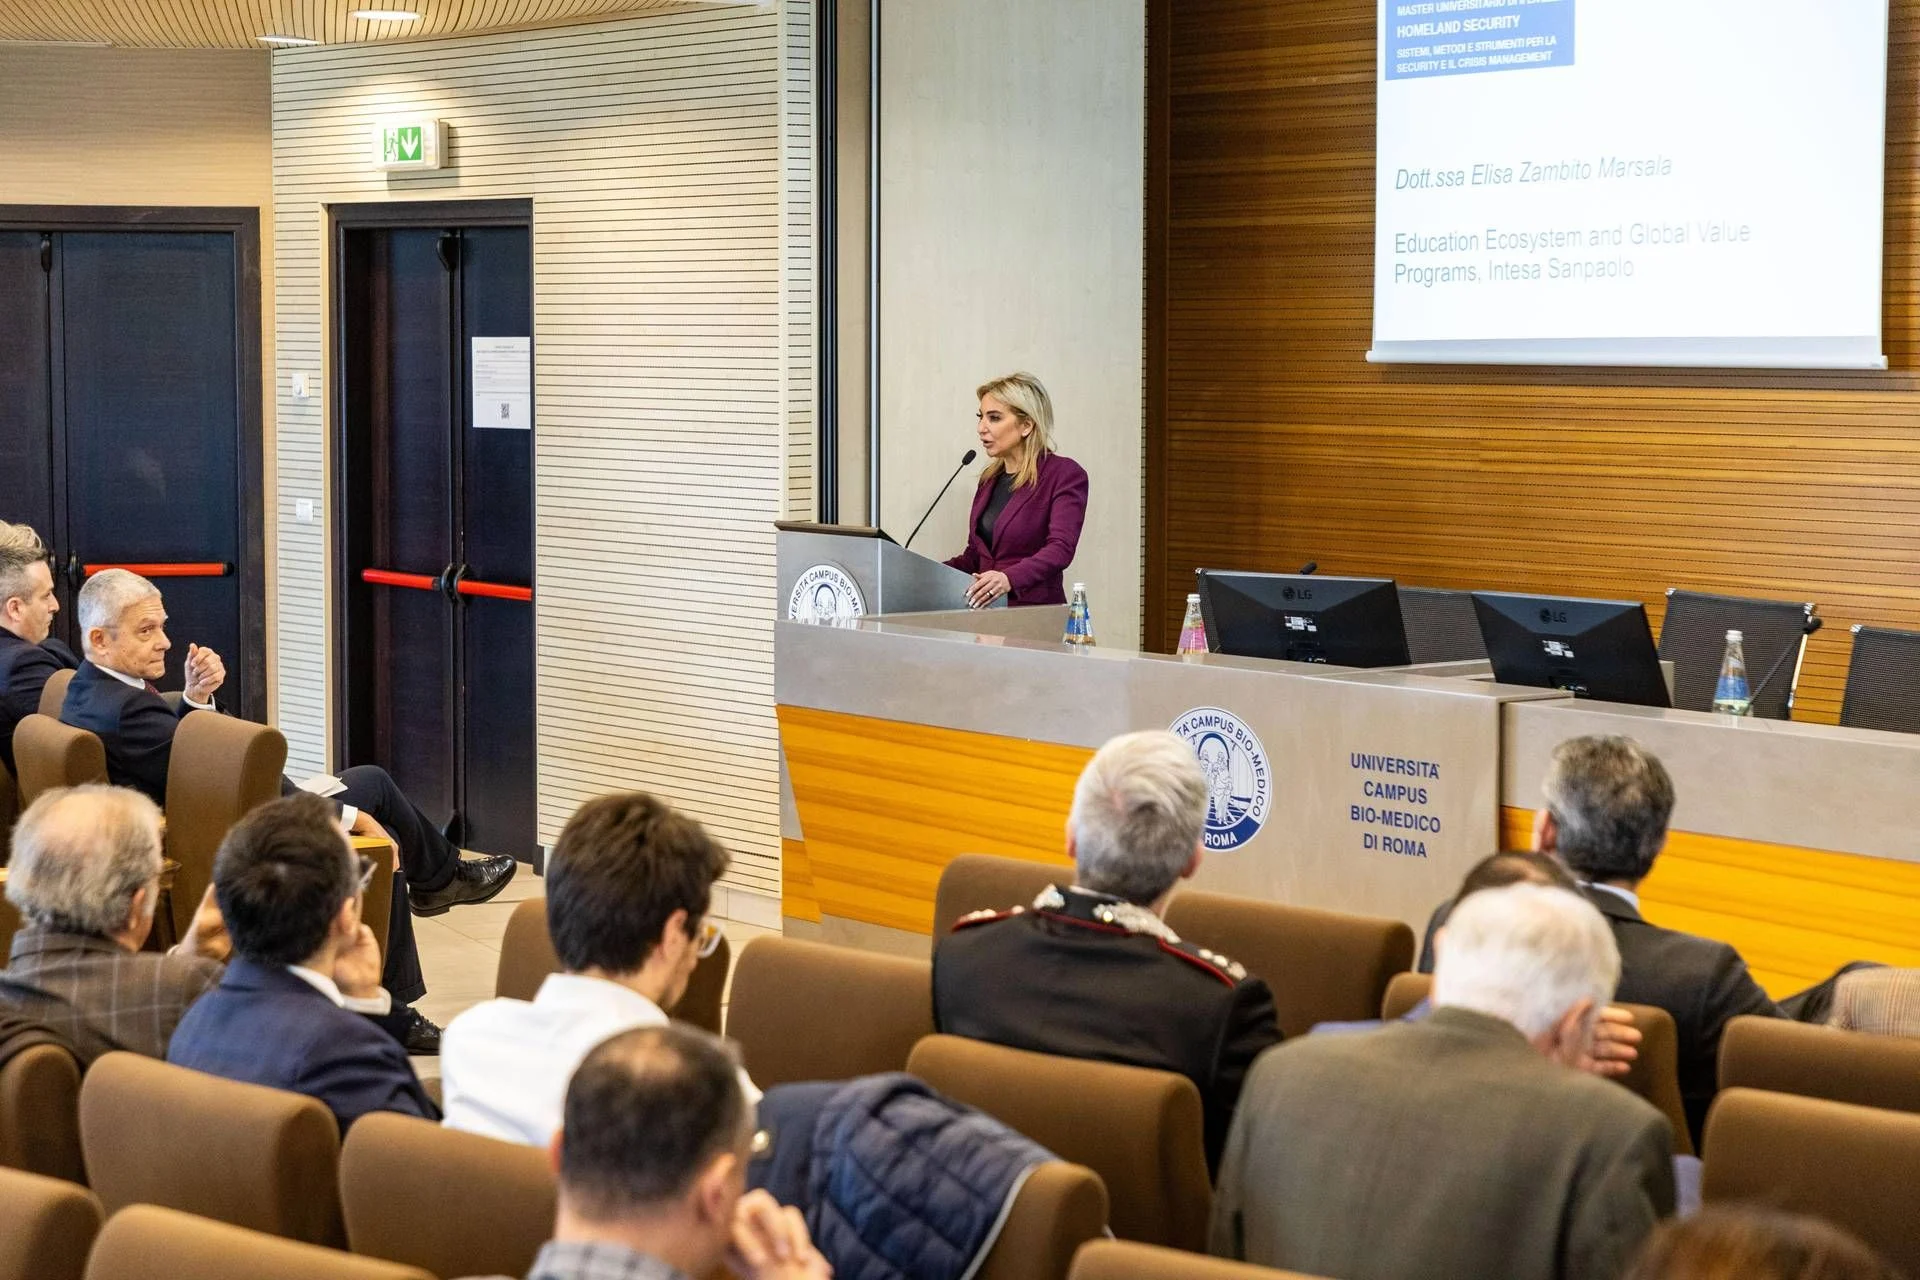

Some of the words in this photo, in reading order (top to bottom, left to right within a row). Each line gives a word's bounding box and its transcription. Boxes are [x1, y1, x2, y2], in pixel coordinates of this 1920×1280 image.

[1397, 3, 1434, 16] MASTER
[1397, 20, 1461, 38] HOMELAND
[1463, 15, 1520, 32] SECURITY
[1526, 36, 1544, 48] PER
[1545, 35, 1557, 46] LA
[1397, 60, 1439, 73] SECURITY
[1488, 51, 1552, 65] MANAGEMENT
[1395, 168, 1465, 190] Dott.ssa
[1471, 163, 1513, 186] Elisa
[1519, 159, 1592, 183] Zambito
[1597, 154, 1673, 179] Marsala
[1395, 231, 1479, 254] Education
[1486, 228, 1583, 254] Ecosystem
[1589, 225, 1622, 247] and
[1630, 221, 1690, 245] Global
[1698, 219, 1751, 243] Value
[1395, 263, 1481, 288] Programs,
[1489, 260, 1541, 281] Intesa
[1548, 256, 1634, 282] Sanpaolo
[809, 570, 839, 584] CAMPUS
[839, 578, 861, 617] BIO-ME
[1297, 589, 1313, 600] LG
[1552, 610, 1568, 624] LG
[1190, 715, 1234, 733] CAMPUS
[1235, 728, 1267, 817] BIO-MEDICO
[1364, 781, 1427, 804] CAMPUS
[1351, 805, 1441, 833] BIO-MEDICO
[1204, 831, 1238, 846] ROMA
[1364, 833, 1378, 850] DI
[1382, 836, 1427, 858] ROMA
